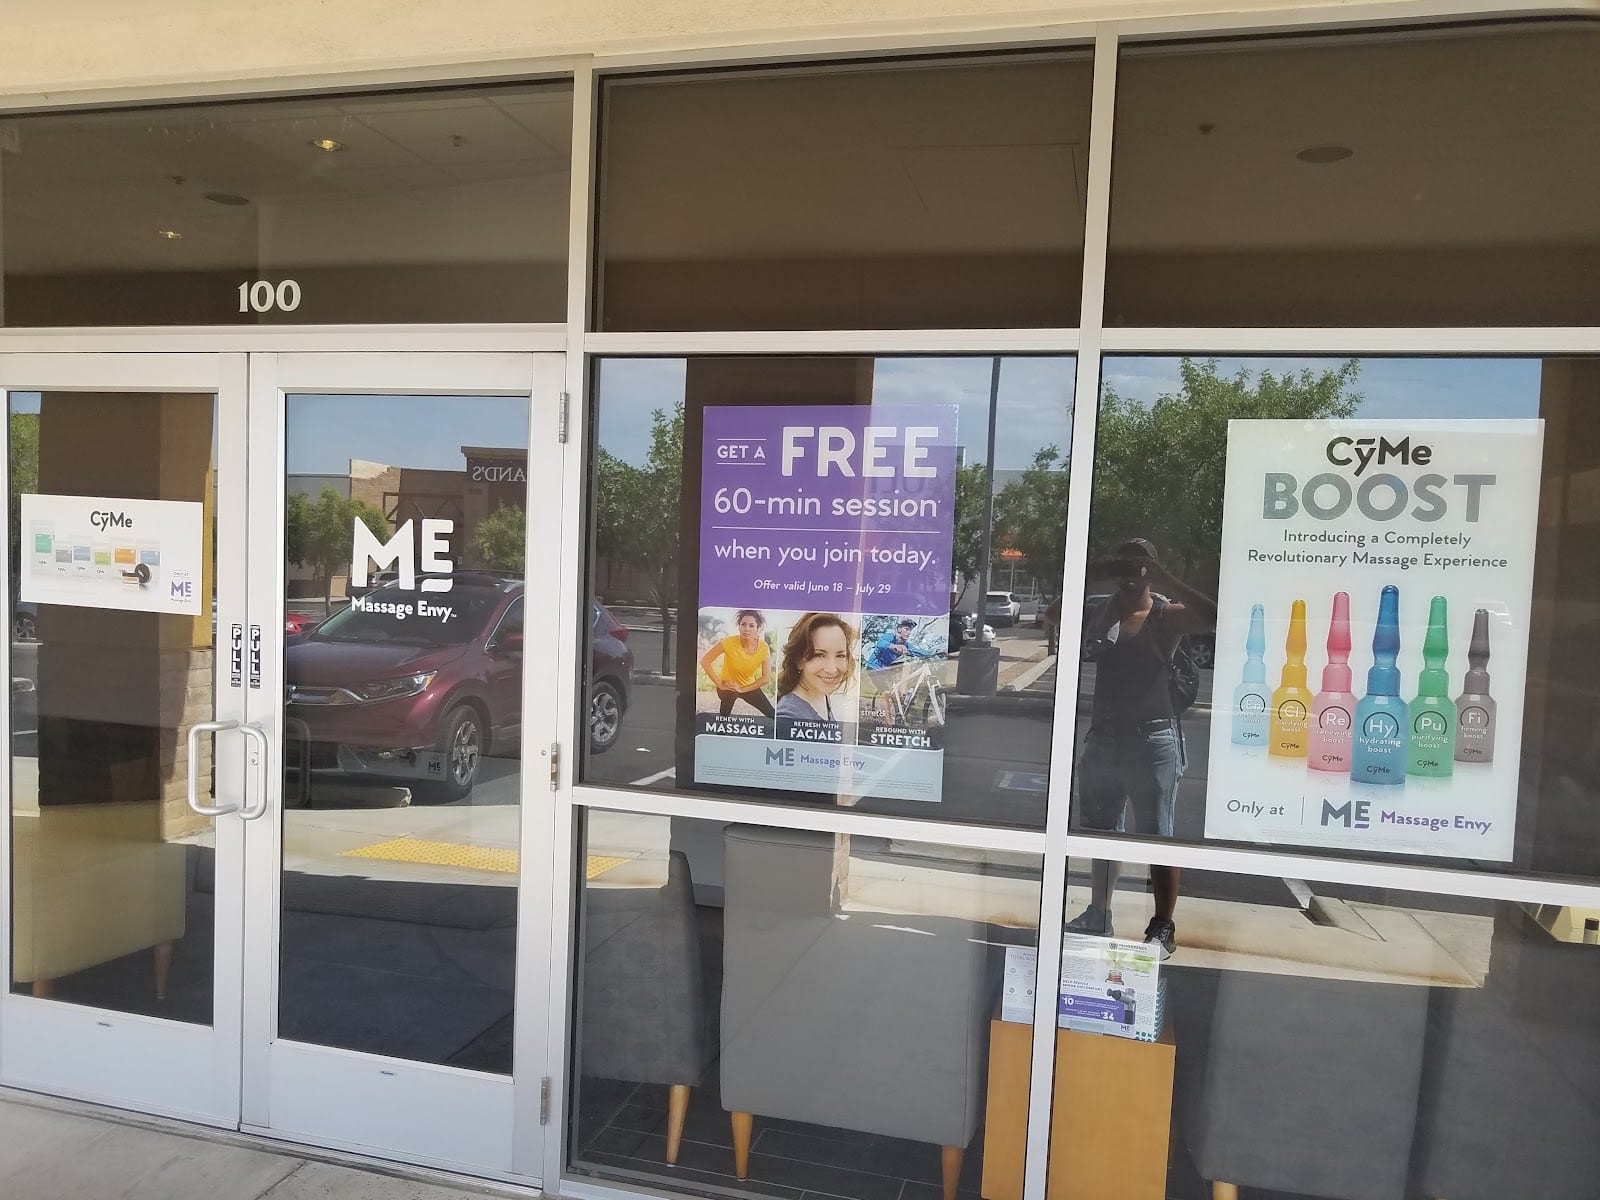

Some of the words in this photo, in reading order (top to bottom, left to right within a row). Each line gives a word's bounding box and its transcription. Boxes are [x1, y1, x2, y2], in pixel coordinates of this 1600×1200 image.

[237, 279, 301, 312] 100
[717, 445, 749, 459] GET
[754, 446, 766, 459] A
[781, 426, 939, 478] FREE
[714, 487, 821, 515] 60-min
[1262, 472, 1497, 523] BOOST
[1283, 529, 1366, 548] Introducing
[1371, 534, 1379, 544] a
[1384, 531, 1472, 549] Completely
[352, 516, 454, 592] ME
[714, 539, 771, 560] when
[778, 546, 817, 567] you
[823, 541, 862, 568] join
[870, 543, 937, 571] today.
[1248, 549, 1348, 567] Revolutionary
[1353, 552, 1419, 570] Massage
[1424, 553, 1508, 571] Experience
[170, 580, 192, 597] ME
[753, 579, 781, 590] Offer
[783, 580, 806, 591] valid
[808, 581, 830, 594] June
[832, 582, 843, 592] 18
[856, 583, 875, 596] July
[878, 584, 891, 594] 29
[351, 596, 413, 619] Massage
[232, 627, 241, 673] PULL
[251, 629, 260, 674] PULL
[793, 720, 821, 729] REFRESH
[822, 722, 839, 730] WITH
[1326, 712, 1346, 726] Re
[1421, 717, 1442, 731] Pu
[1468, 712, 1481, 724] Fi
[705, 722, 765, 736] MASSAGE
[790, 728, 842, 742] FACIALS
[875, 726, 907, 734] REBOUND
[1369, 719, 1395, 738] Hy
[870, 733, 931, 748] STRETCH
[1360, 737, 1401, 748] hydrating
[1411, 734, 1448, 744] purifying
[1418, 741, 1440, 749] boost
[765, 746, 795, 767] ME
[1367, 746, 1392, 754] boost
[800, 753, 841, 768] Massage
[843, 756, 866, 770] Envy
[1227, 799, 1264, 818] Only
[1269, 804, 1285, 816] at
[1320, 798, 1371, 829] ME
[1380, 810, 1449, 832] Massage
[1453, 815, 1493, 835] Envy
